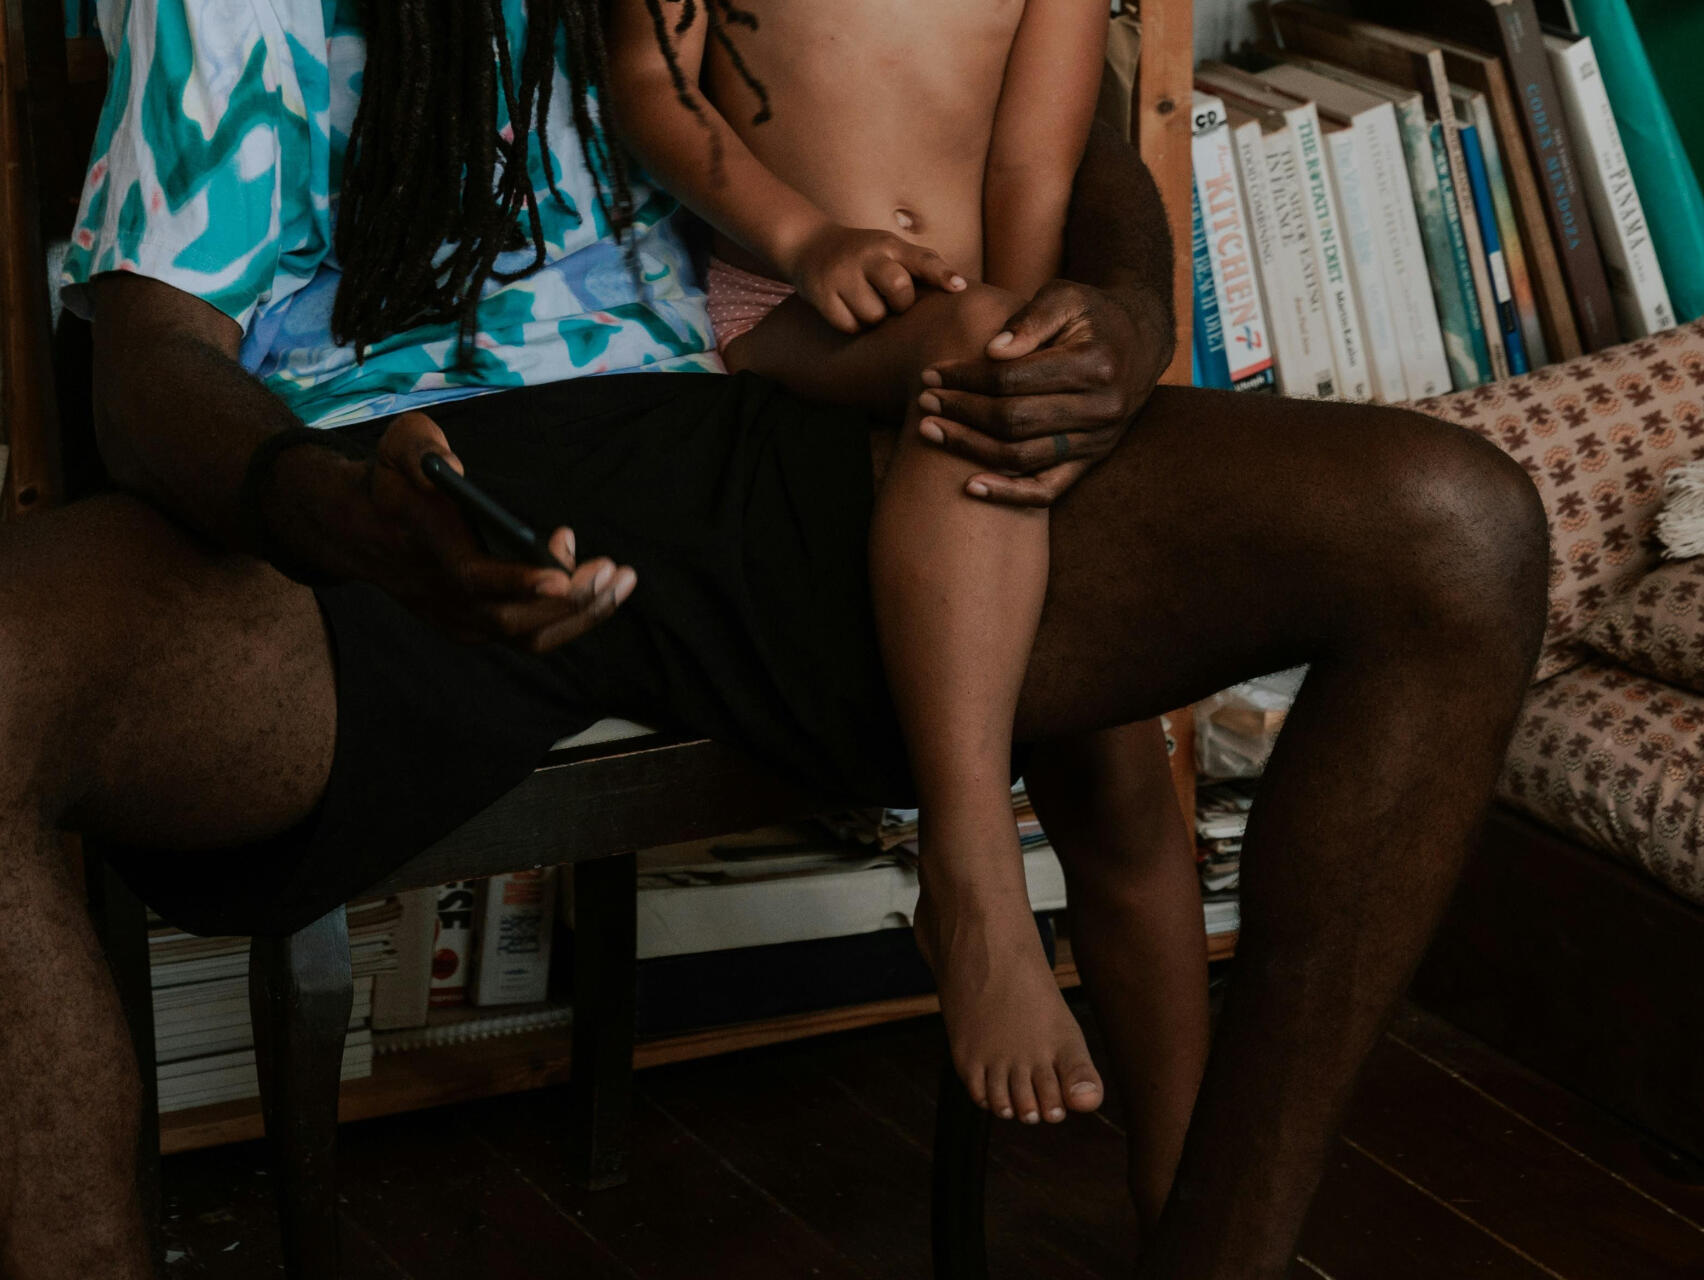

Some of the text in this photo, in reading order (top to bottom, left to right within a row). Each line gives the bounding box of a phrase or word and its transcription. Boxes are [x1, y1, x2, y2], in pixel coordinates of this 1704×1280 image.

[1195, 110, 1218, 129] CD
[1297, 120, 1318, 159] THE
[1240, 141, 1274, 265] FOOD COMBINING
[1264, 151, 1295, 249] IN FRANCE
[1525, 82, 1581, 251] CODEX MENDOZA
[1279, 146, 1321, 314] THE ART OF EATING
[1607, 168, 1648, 254] PANAMA
[1204, 174, 1259, 327] KITCHEN
[1234, 323, 1262, 352] 7
[1322, 243, 1345, 285] DIET
[1204, 313, 1225, 354] DIET
[1333, 290, 1350, 328] Martin
